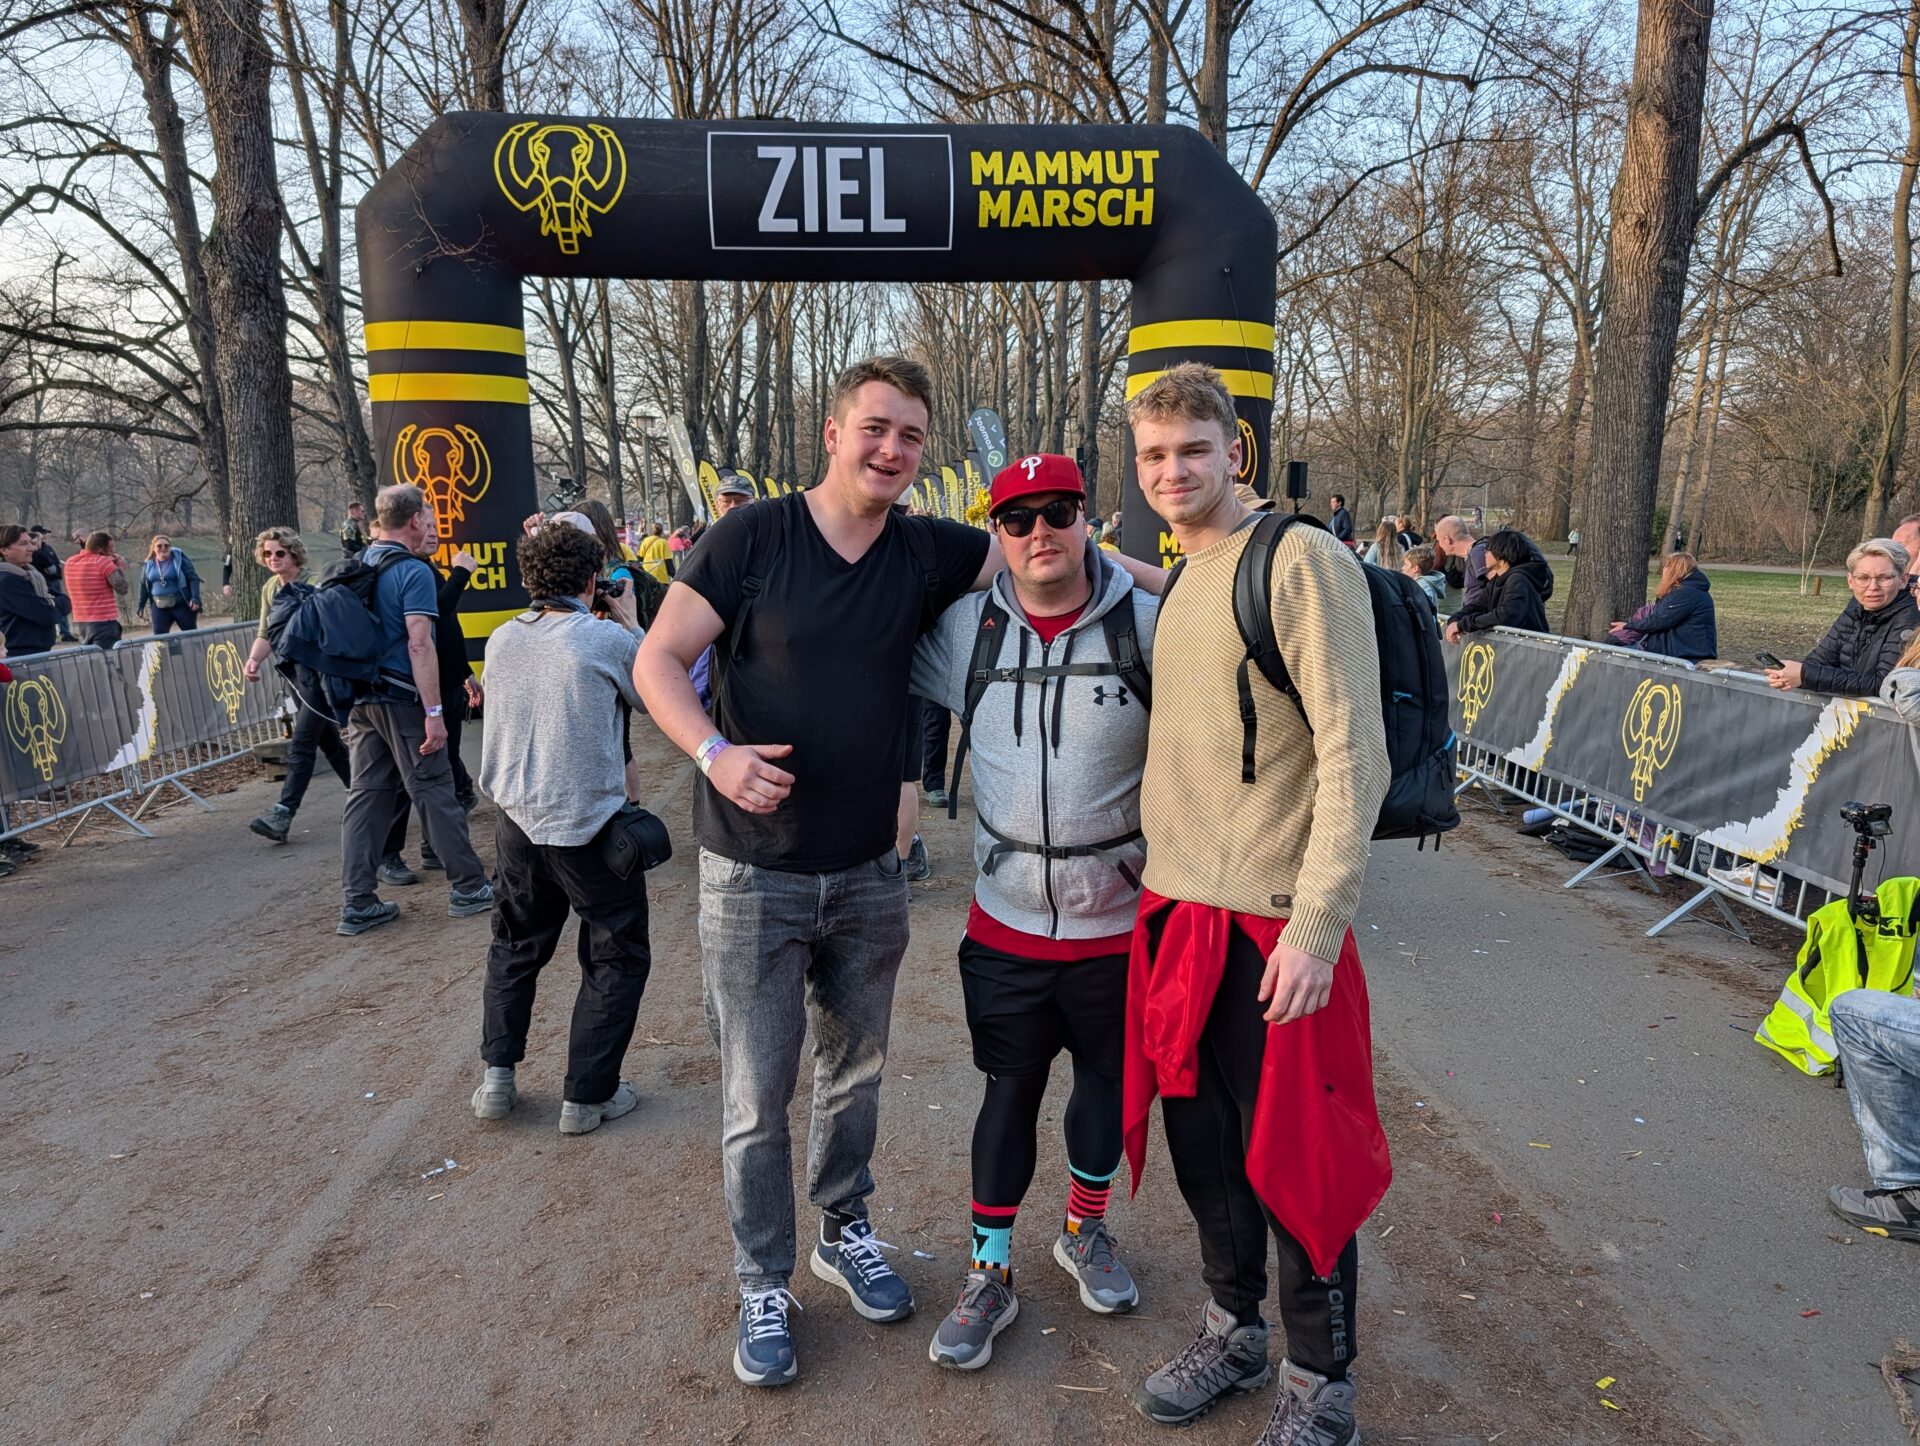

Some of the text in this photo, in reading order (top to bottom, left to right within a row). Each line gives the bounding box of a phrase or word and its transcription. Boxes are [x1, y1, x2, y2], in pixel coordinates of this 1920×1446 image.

[970, 150, 1160, 186] MAMMUT
[757, 146, 907, 233] ZIEL
[978, 188, 1155, 228] MARSCH
[1020, 456, 1043, 480] P
[429, 541, 507, 569] MMUT
[1328, 1289, 1347, 1361] BRUNO
